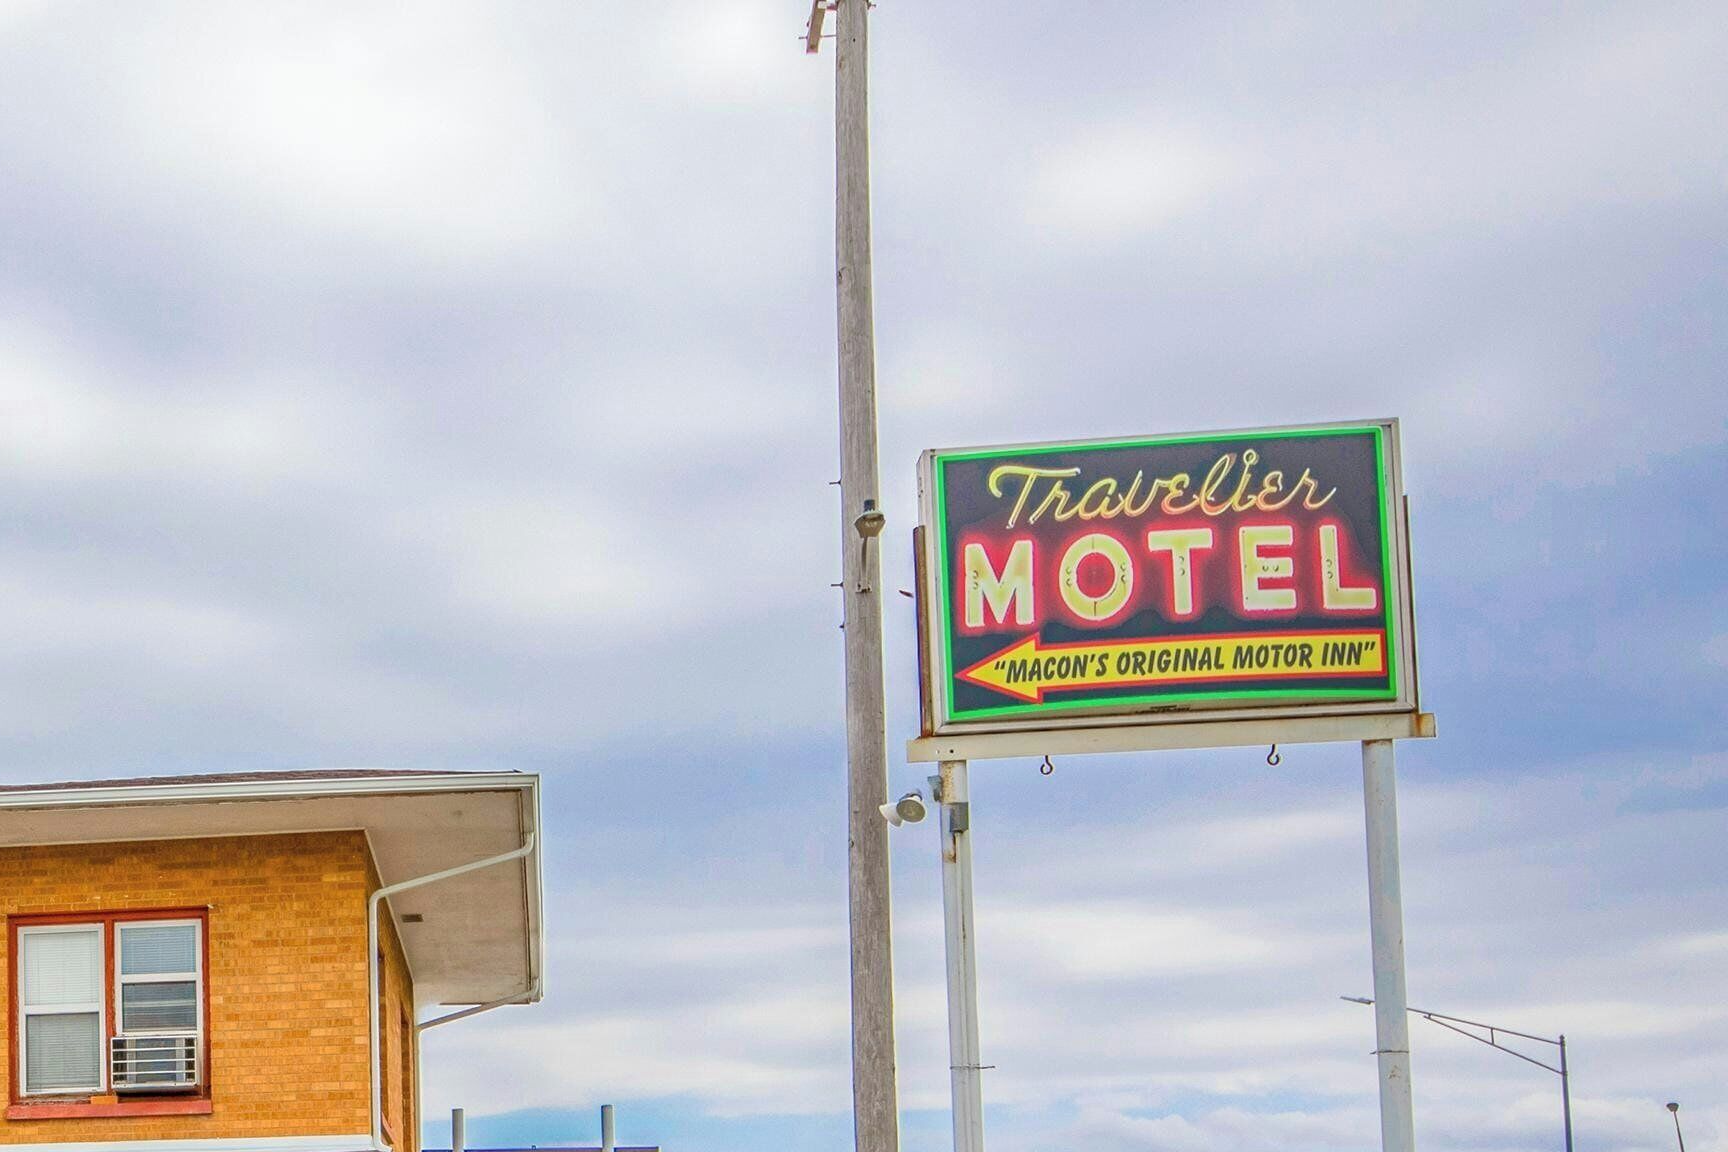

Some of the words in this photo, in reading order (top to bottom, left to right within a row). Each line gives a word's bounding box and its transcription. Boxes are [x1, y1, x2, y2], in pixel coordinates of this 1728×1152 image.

[964, 525, 1377, 628] MOTEL
[1116, 645, 1225, 676] ORIGINAL
[1232, 642, 1314, 671] MOTOR
